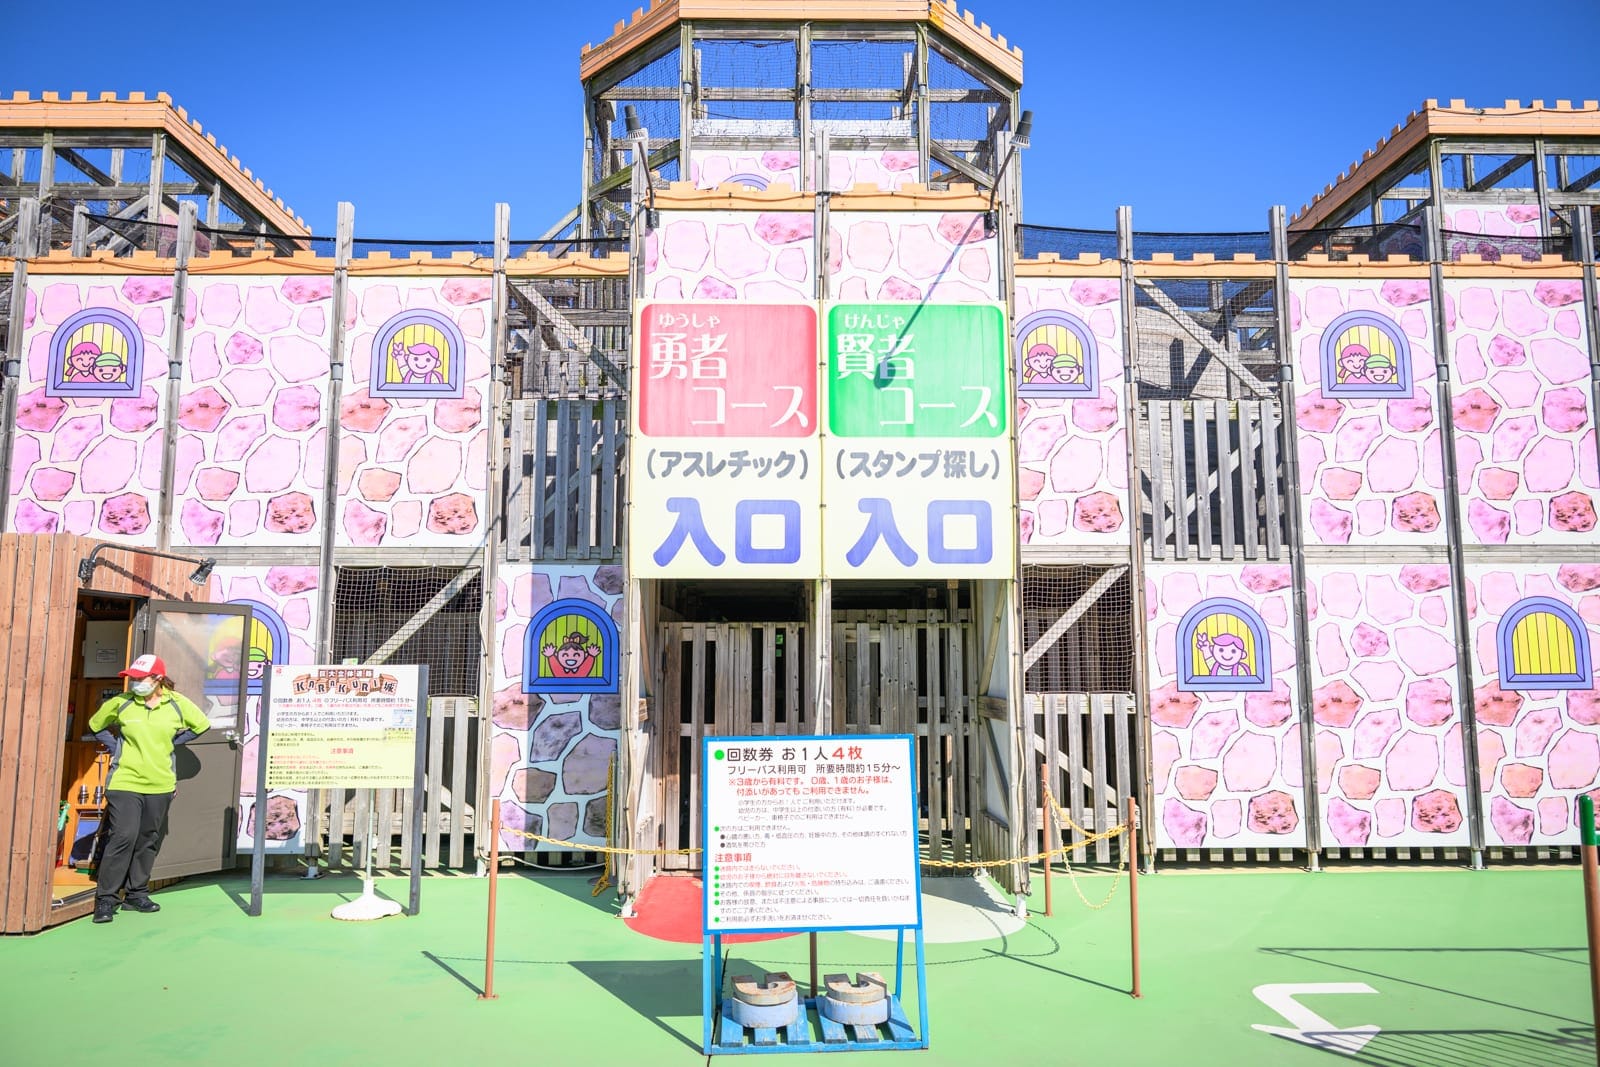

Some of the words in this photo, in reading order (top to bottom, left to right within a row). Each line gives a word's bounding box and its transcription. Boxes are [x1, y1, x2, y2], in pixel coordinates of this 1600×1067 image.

[658, 314, 721, 329] ゆうしゃ
[844, 314, 905, 329] けんじゃ
[651, 333, 728, 380] 勇者
[837, 333, 915, 380] 賢者
[691, 385, 808, 428] コース
[880, 385, 998, 428] コース
[647, 449, 808, 480] （アスレチック）
[837, 449, 1000, 480] （スタンプ探し）
[652, 497, 801, 567] 入口
[846, 497, 993, 567] 入口
[727, 748, 774, 762] 回数券
[728, 764, 806, 775] フリーパス利用可
[714, 852, 752, 863] 注意事項
